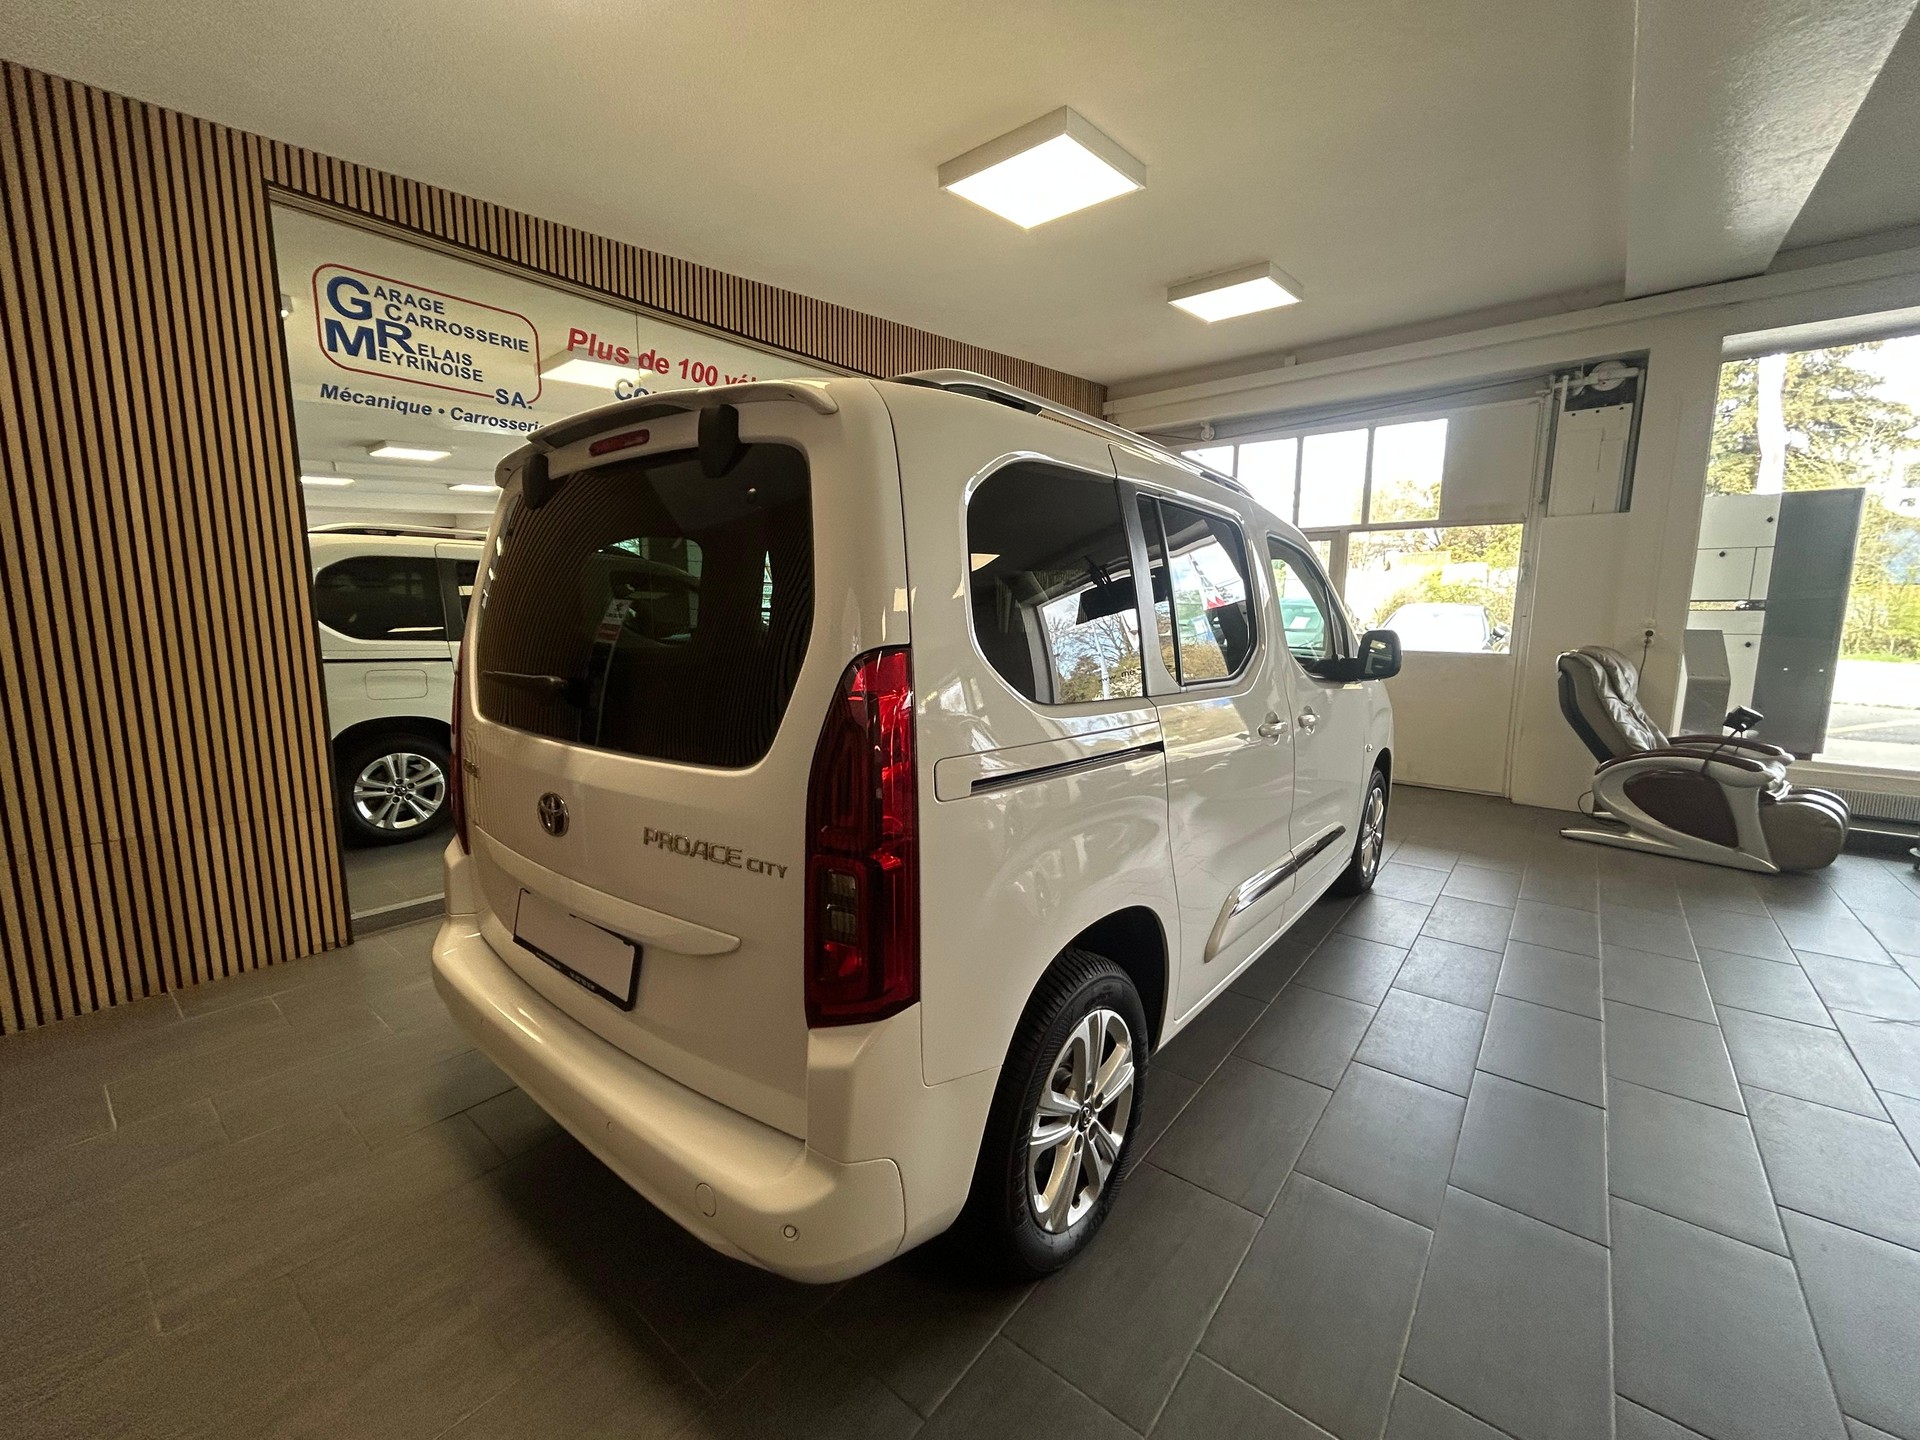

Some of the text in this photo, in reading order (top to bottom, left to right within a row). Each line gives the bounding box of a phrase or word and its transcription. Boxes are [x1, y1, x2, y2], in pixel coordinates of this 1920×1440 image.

[327, 276, 445, 320] GARAGE
[324, 317, 484, 383] MEYRINOISE
[376, 317, 473, 367] RELAIS
[384, 303, 530, 353] CARROSSERIE
[567, 327, 630, 365] Plus
[638, 349, 670, 375] de
[678, 358, 718, 386] 100
[319, 383, 545, 432] Mécanique Carrosseri
[643, 826, 788, 879] PROACE CITY
